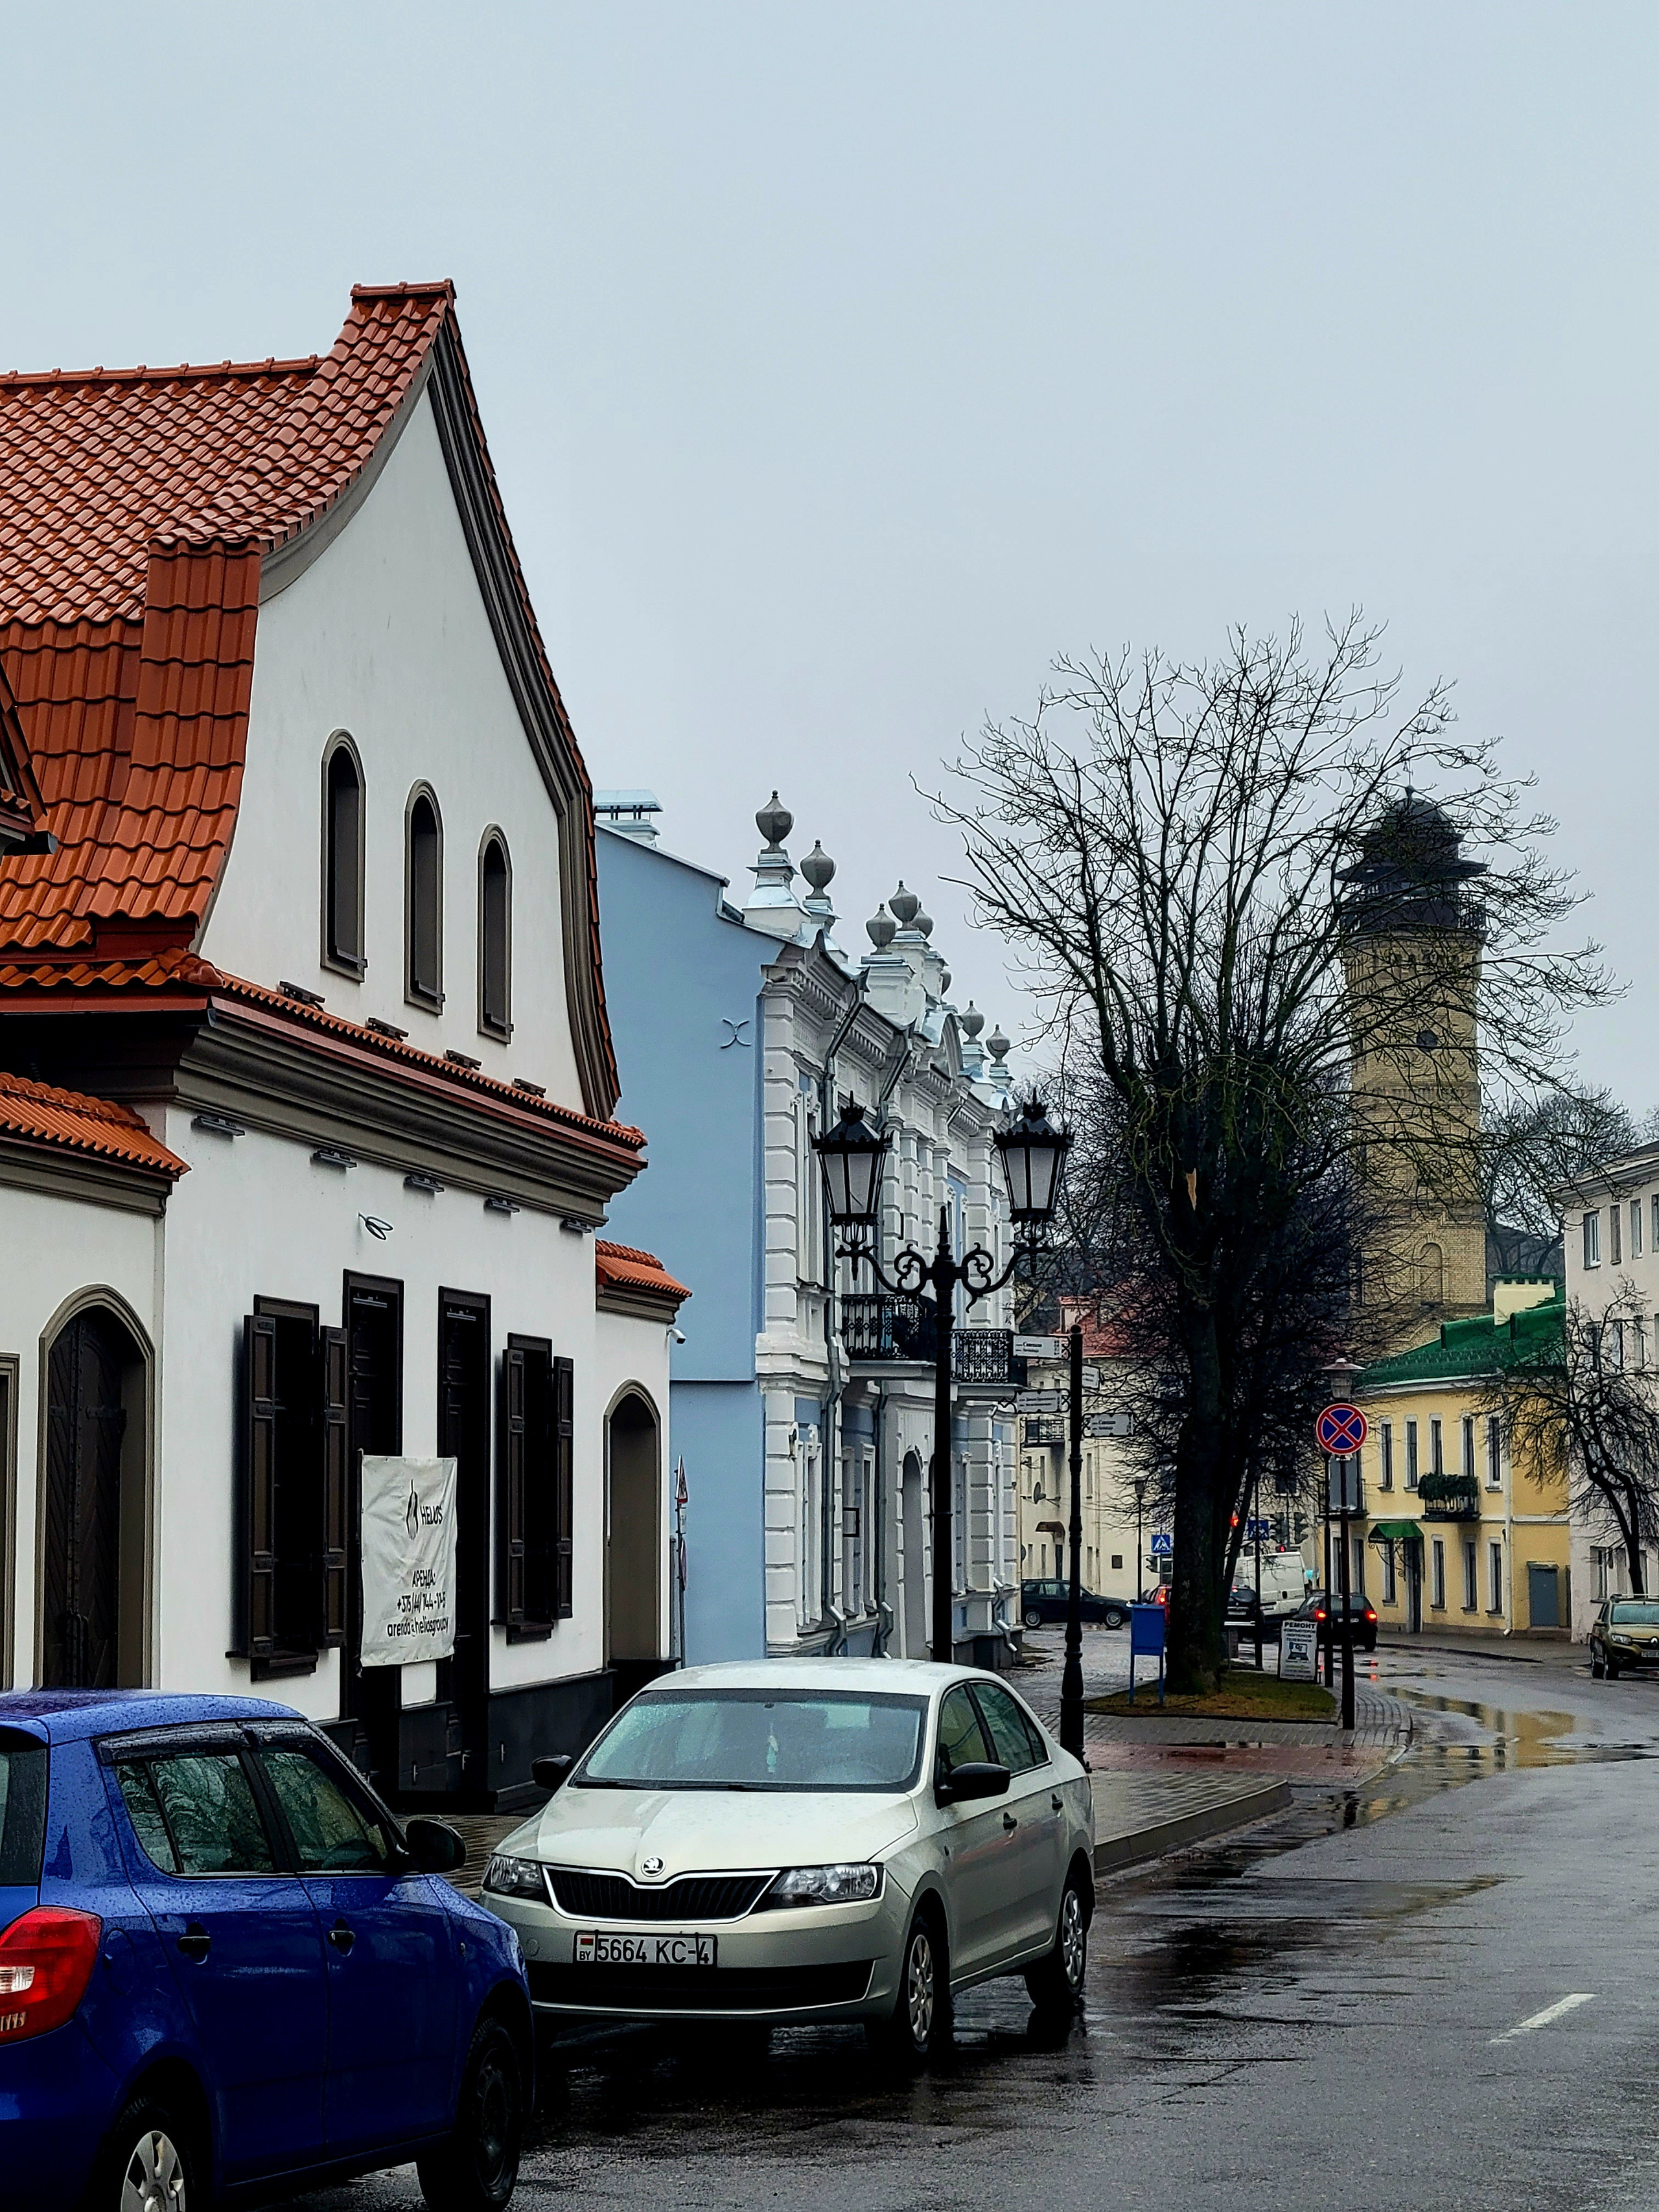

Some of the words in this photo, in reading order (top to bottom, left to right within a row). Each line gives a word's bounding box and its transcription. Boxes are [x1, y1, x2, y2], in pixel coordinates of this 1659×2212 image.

[420, 1505, 443, 1525] HELIOS
[412, 1569, 436, 1589] АРЕНДА:
[579, 1950, 591, 1961] BY
[597, 1938, 647, 1962] 5664
[655, 1940, 710, 1964] KC-4
